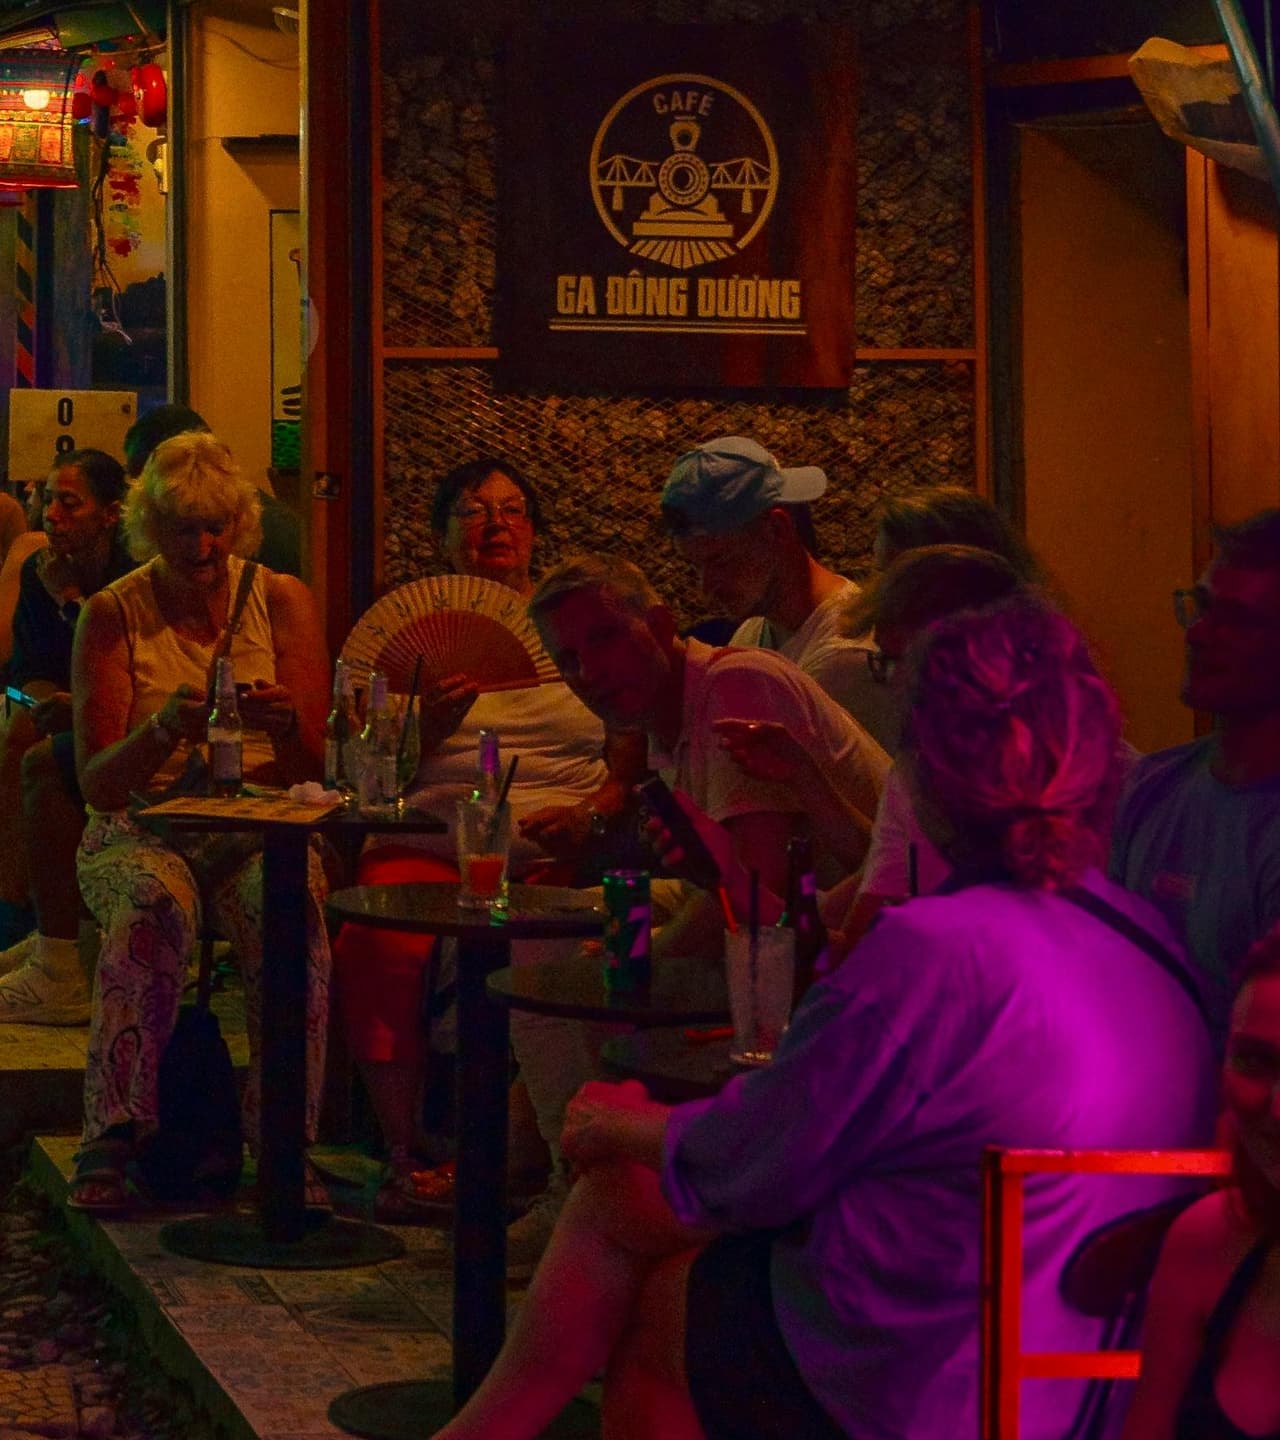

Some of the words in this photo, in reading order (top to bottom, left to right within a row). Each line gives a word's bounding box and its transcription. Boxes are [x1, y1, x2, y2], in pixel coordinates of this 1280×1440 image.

[652, 89, 715, 118] CAFÉ
[556, 274, 598, 318] GA
[606, 267, 689, 318] ĐÔNG
[697, 273, 802, 320] DƯƠNG
